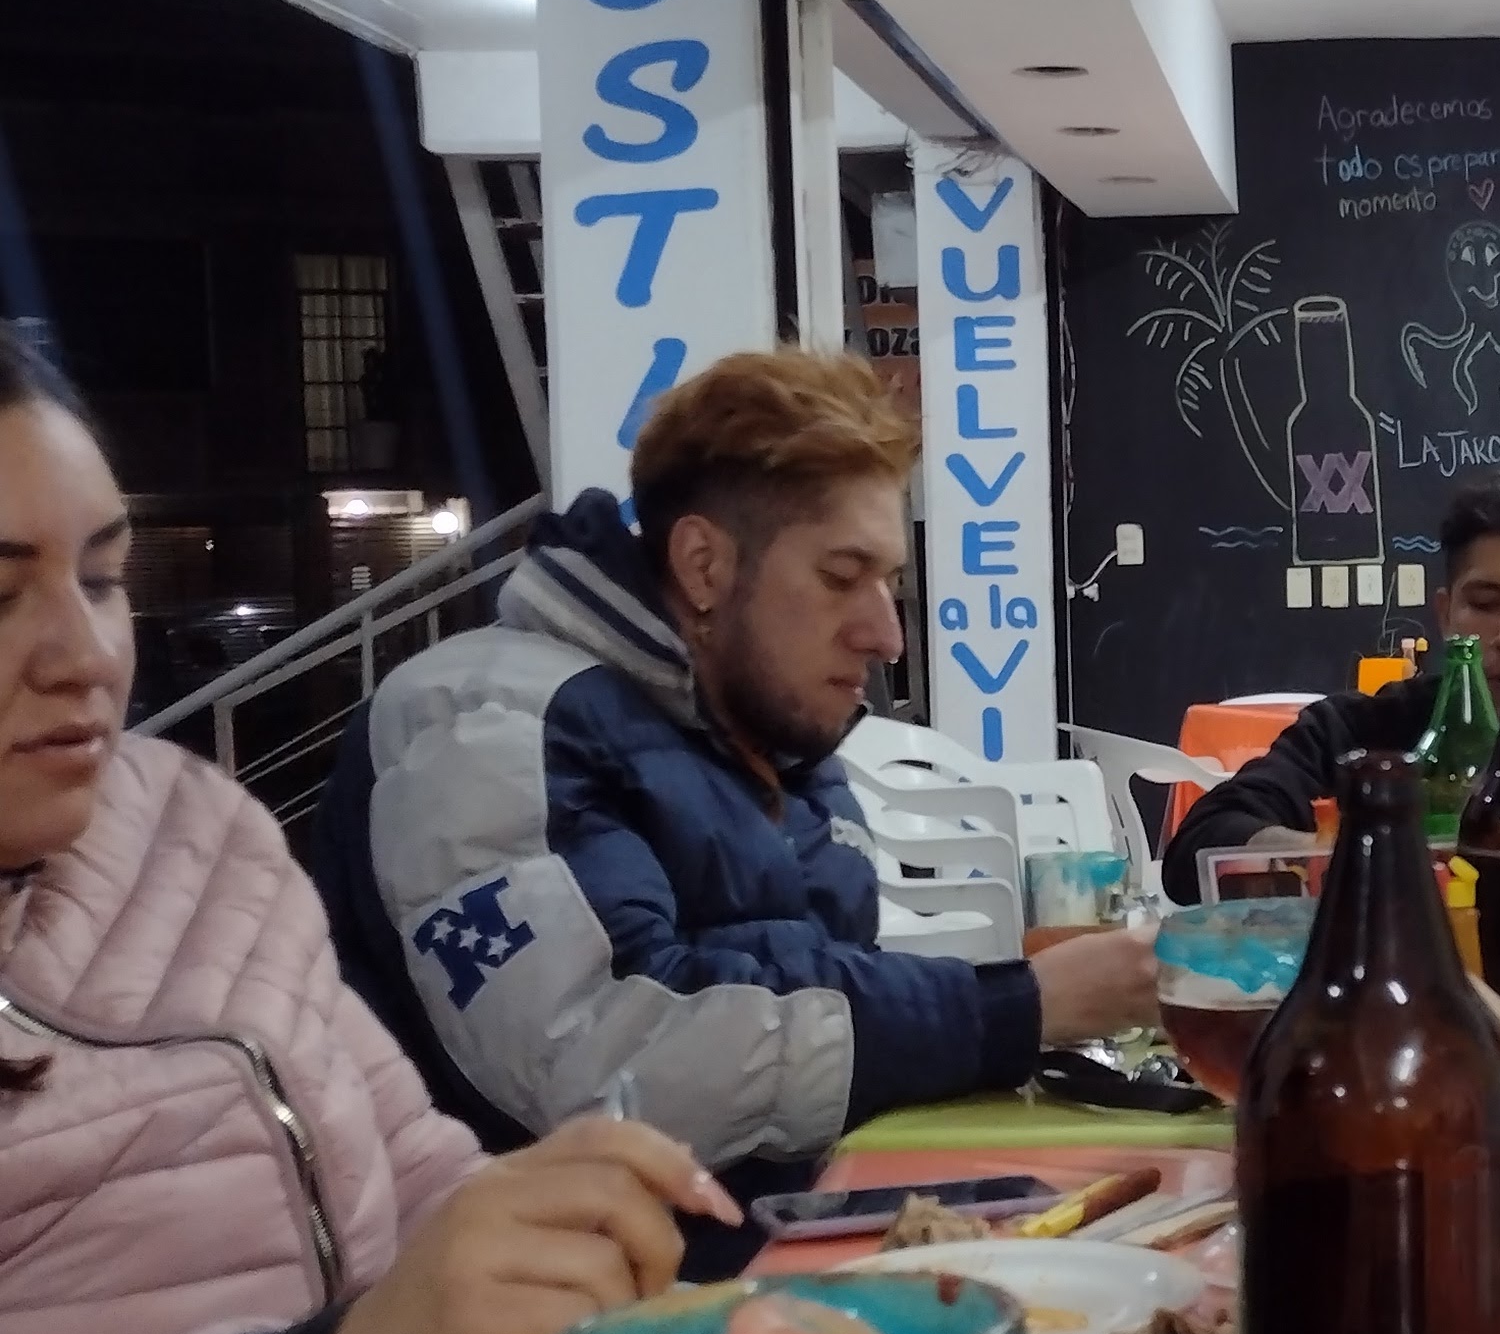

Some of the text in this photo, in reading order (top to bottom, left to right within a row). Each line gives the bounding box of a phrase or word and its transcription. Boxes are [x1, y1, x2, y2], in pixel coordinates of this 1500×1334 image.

[1317, 94, 1493, 141] Agradecemos
[1315, 143, 1383, 186] todo
[1338, 186, 1437, 220] momento
[935, 176, 1027, 576] VUELVE
[1296, 450, 1374, 514] XX
[939, 583, 1038, 631] a la
